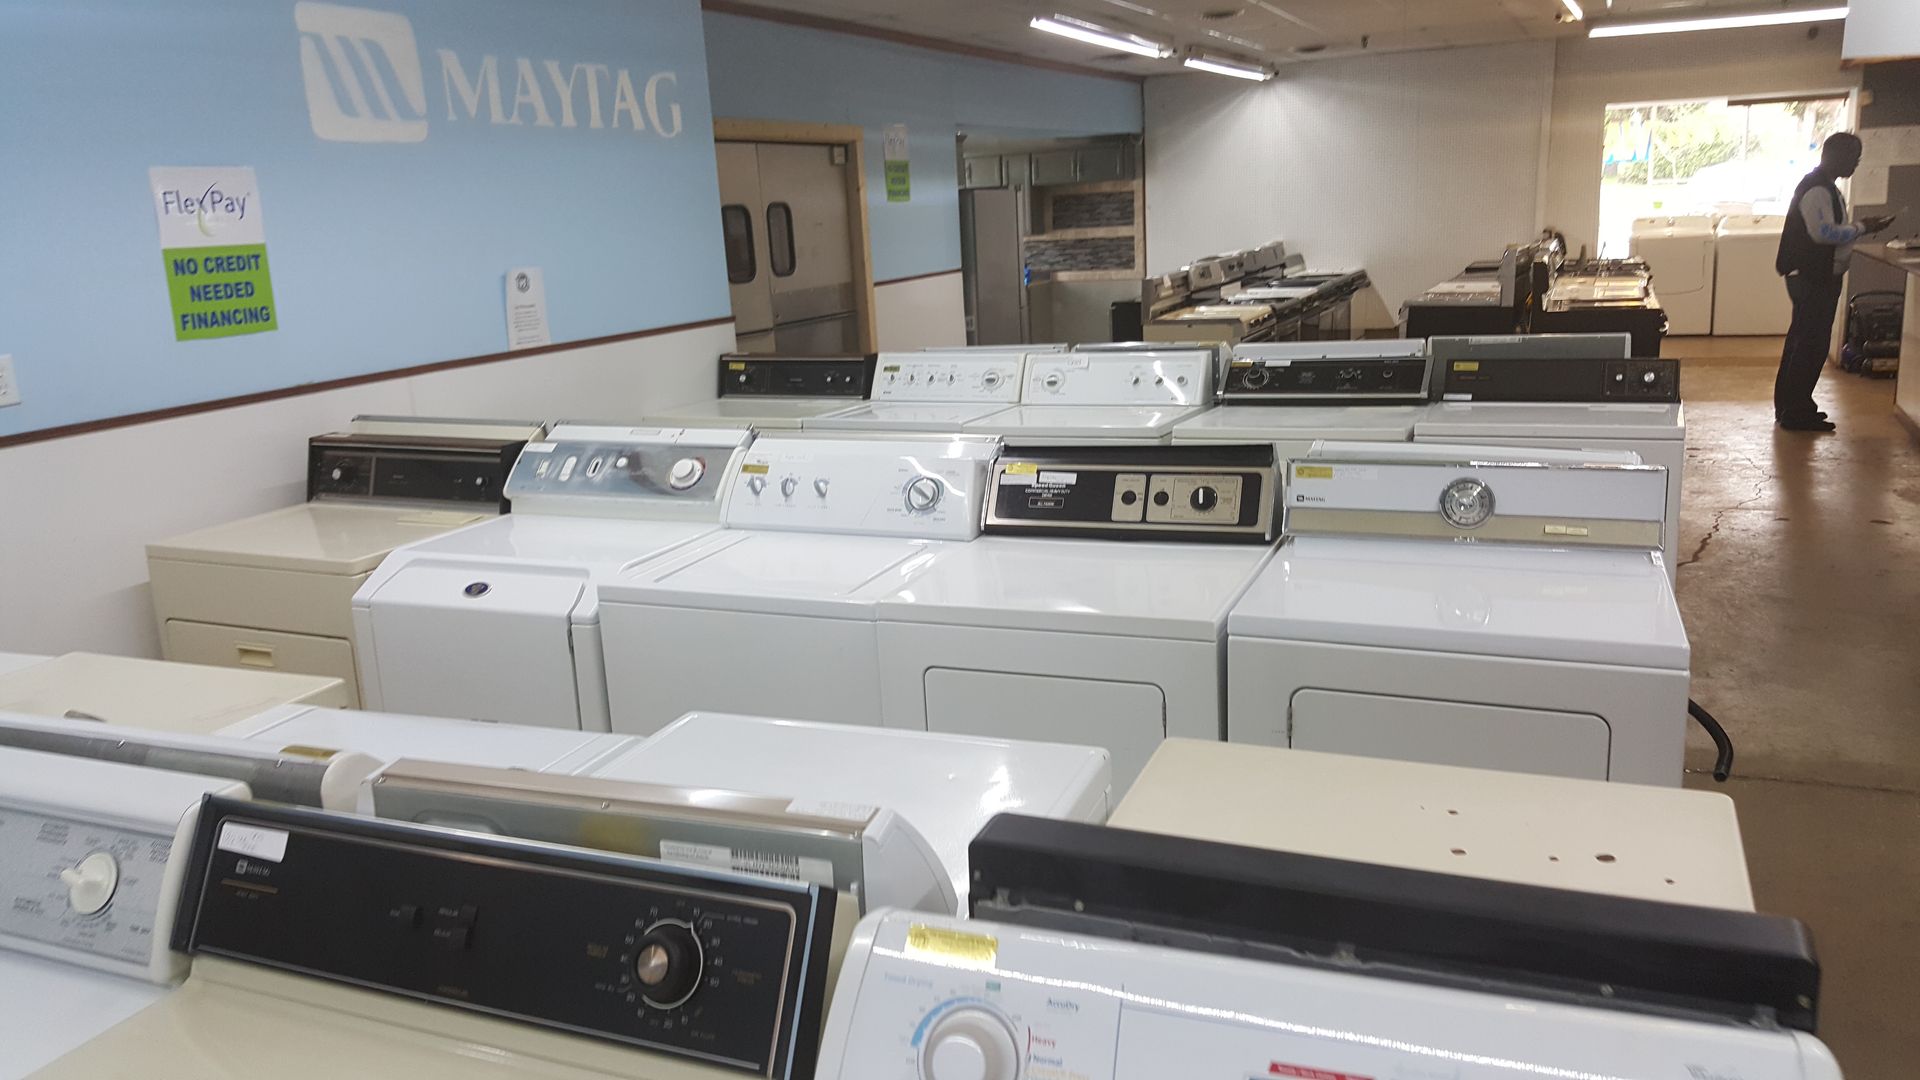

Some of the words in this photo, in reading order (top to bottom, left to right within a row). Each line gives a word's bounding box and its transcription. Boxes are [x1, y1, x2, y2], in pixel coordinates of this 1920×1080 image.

[437, 48, 682, 138] MAYTAG
[162, 182, 247, 220] FlexPay
[173, 258, 198, 276] NO
[203, 254, 261, 274] CREDIT
[190, 281, 255, 303] NEEDED
[181, 306, 270, 331] FINANCING
[1047, 997, 1079, 1013] AccuDry
[1032, 1034, 1056, 1049] Heavy
[1033, 1053, 1063, 1067] Normal
